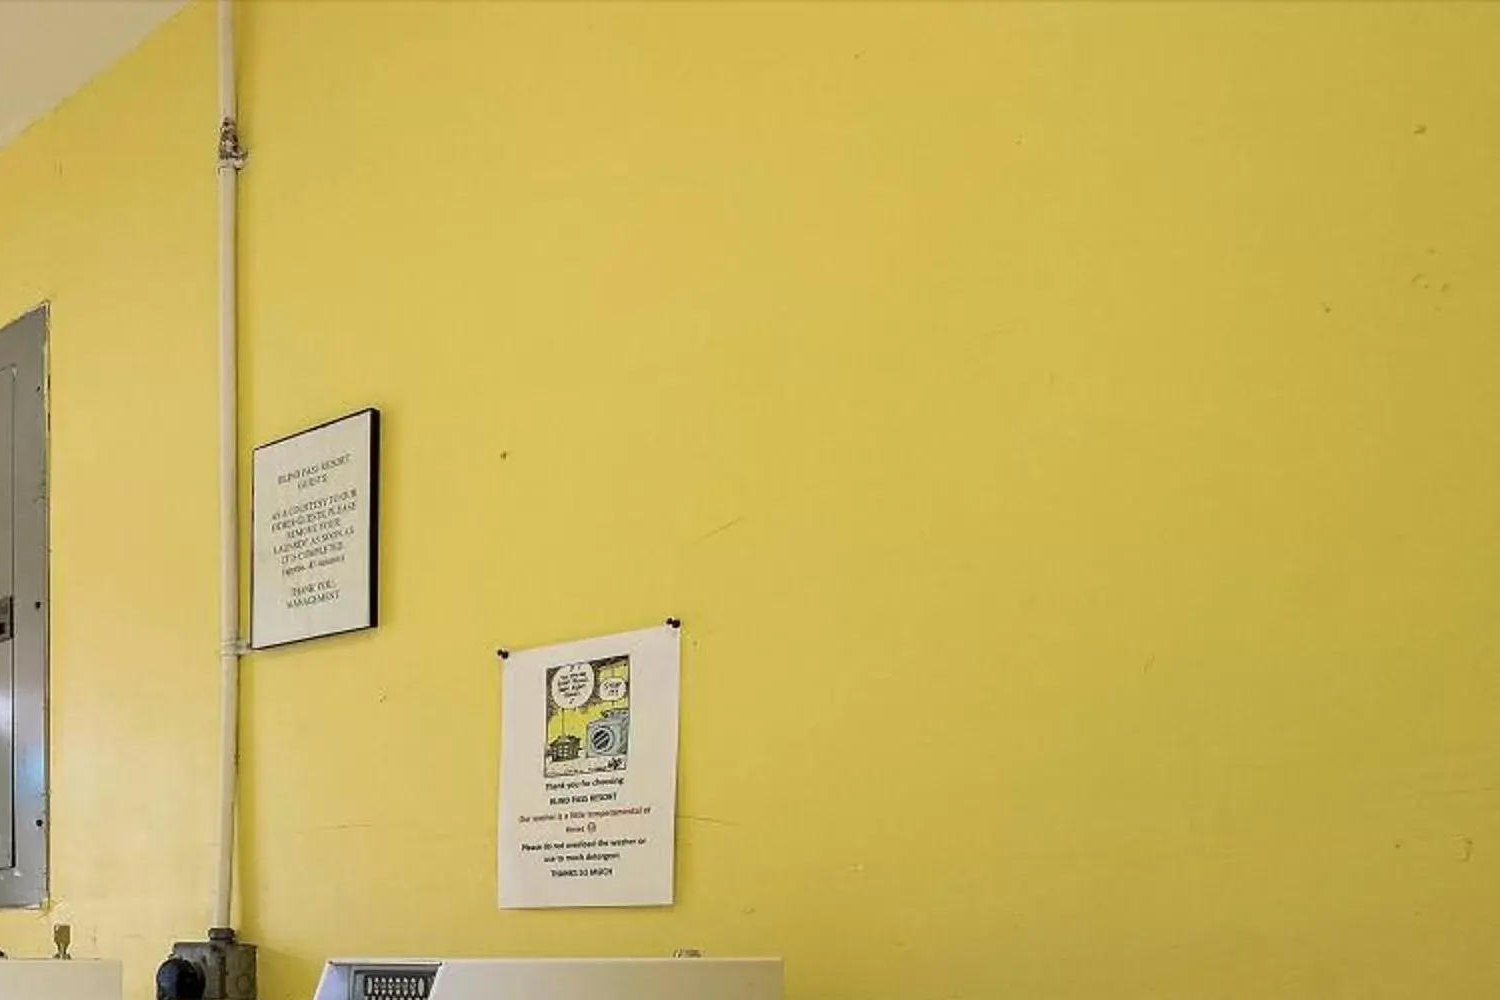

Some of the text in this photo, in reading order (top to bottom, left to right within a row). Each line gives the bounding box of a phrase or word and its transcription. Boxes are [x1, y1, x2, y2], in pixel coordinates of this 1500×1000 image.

[545, 782, 565, 791] Thank
[592, 778, 625, 787] choosing
[590, 792, 617, 802] RESORT
[550, 868, 579, 878] THANKS
